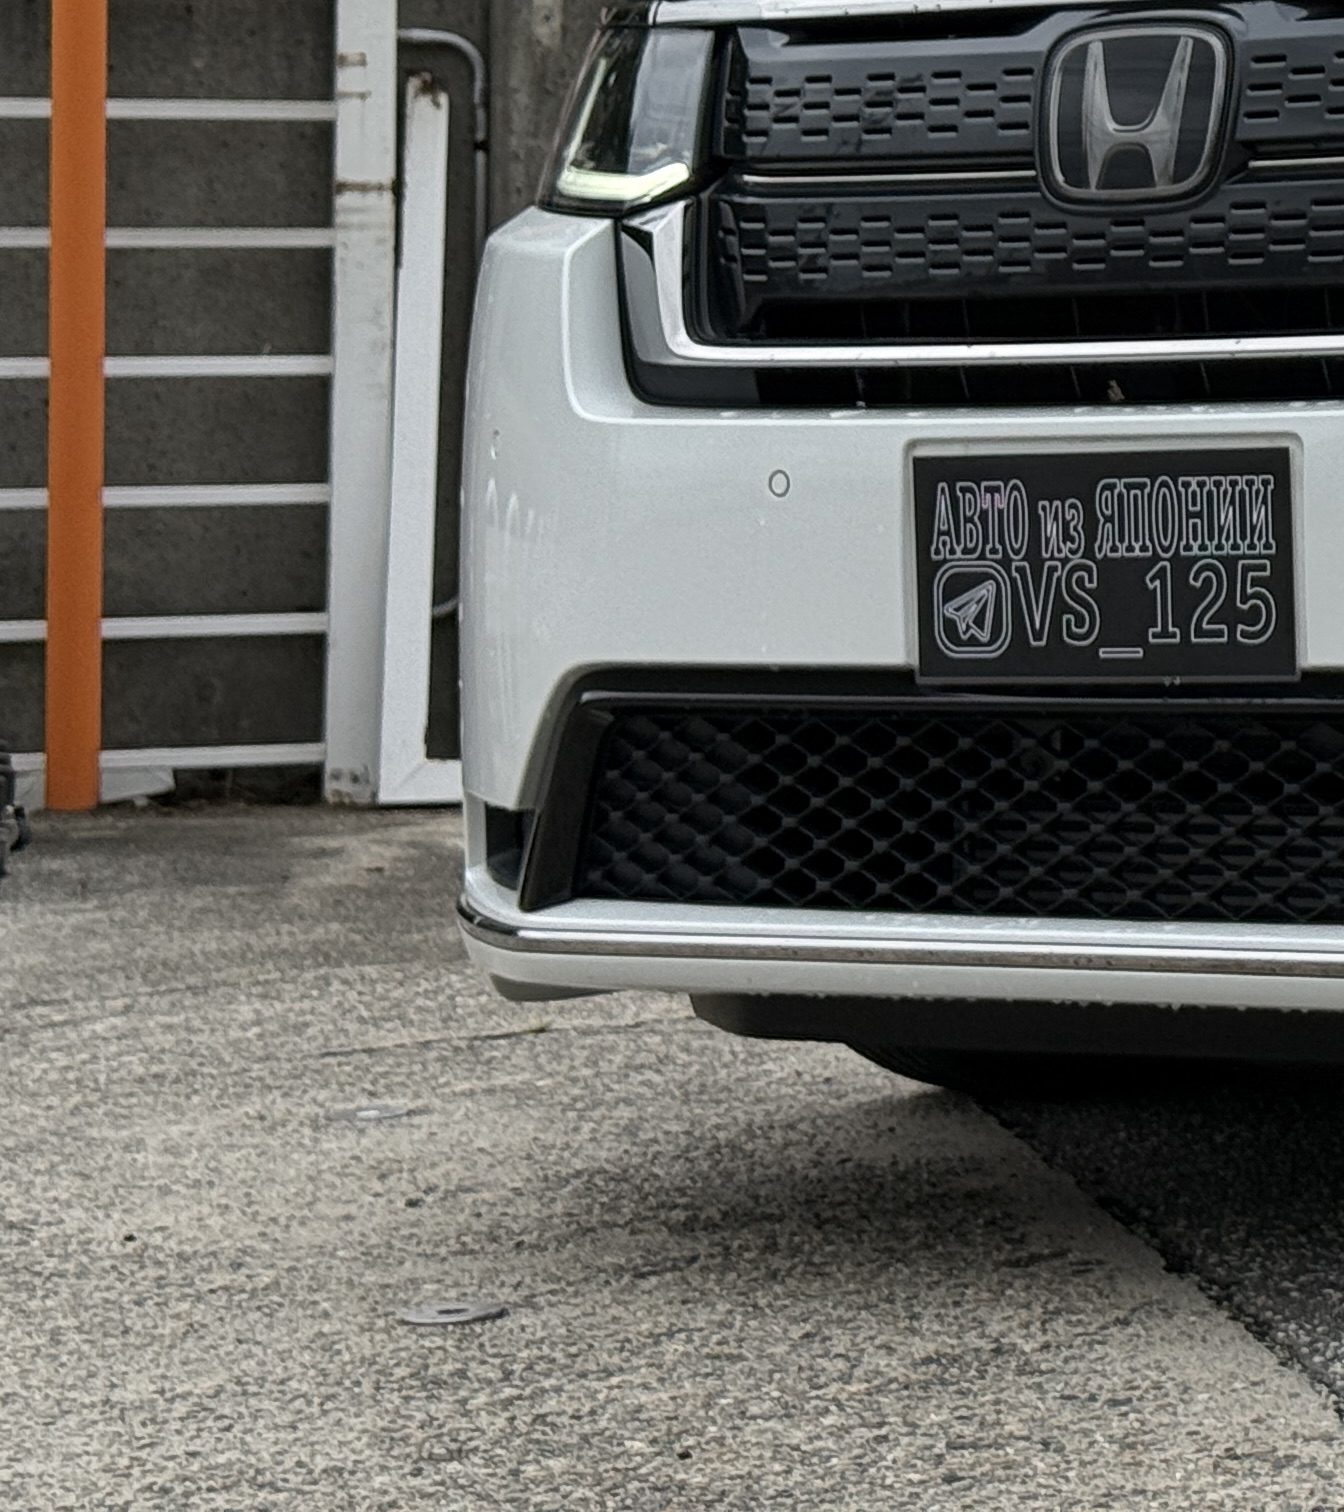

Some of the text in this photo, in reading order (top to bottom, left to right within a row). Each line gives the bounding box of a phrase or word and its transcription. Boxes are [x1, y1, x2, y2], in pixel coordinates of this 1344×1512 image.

[931, 475, 1277, 560] АВТО из ЯПОНИИ
[1012, 559, 1277, 659] VS_125
